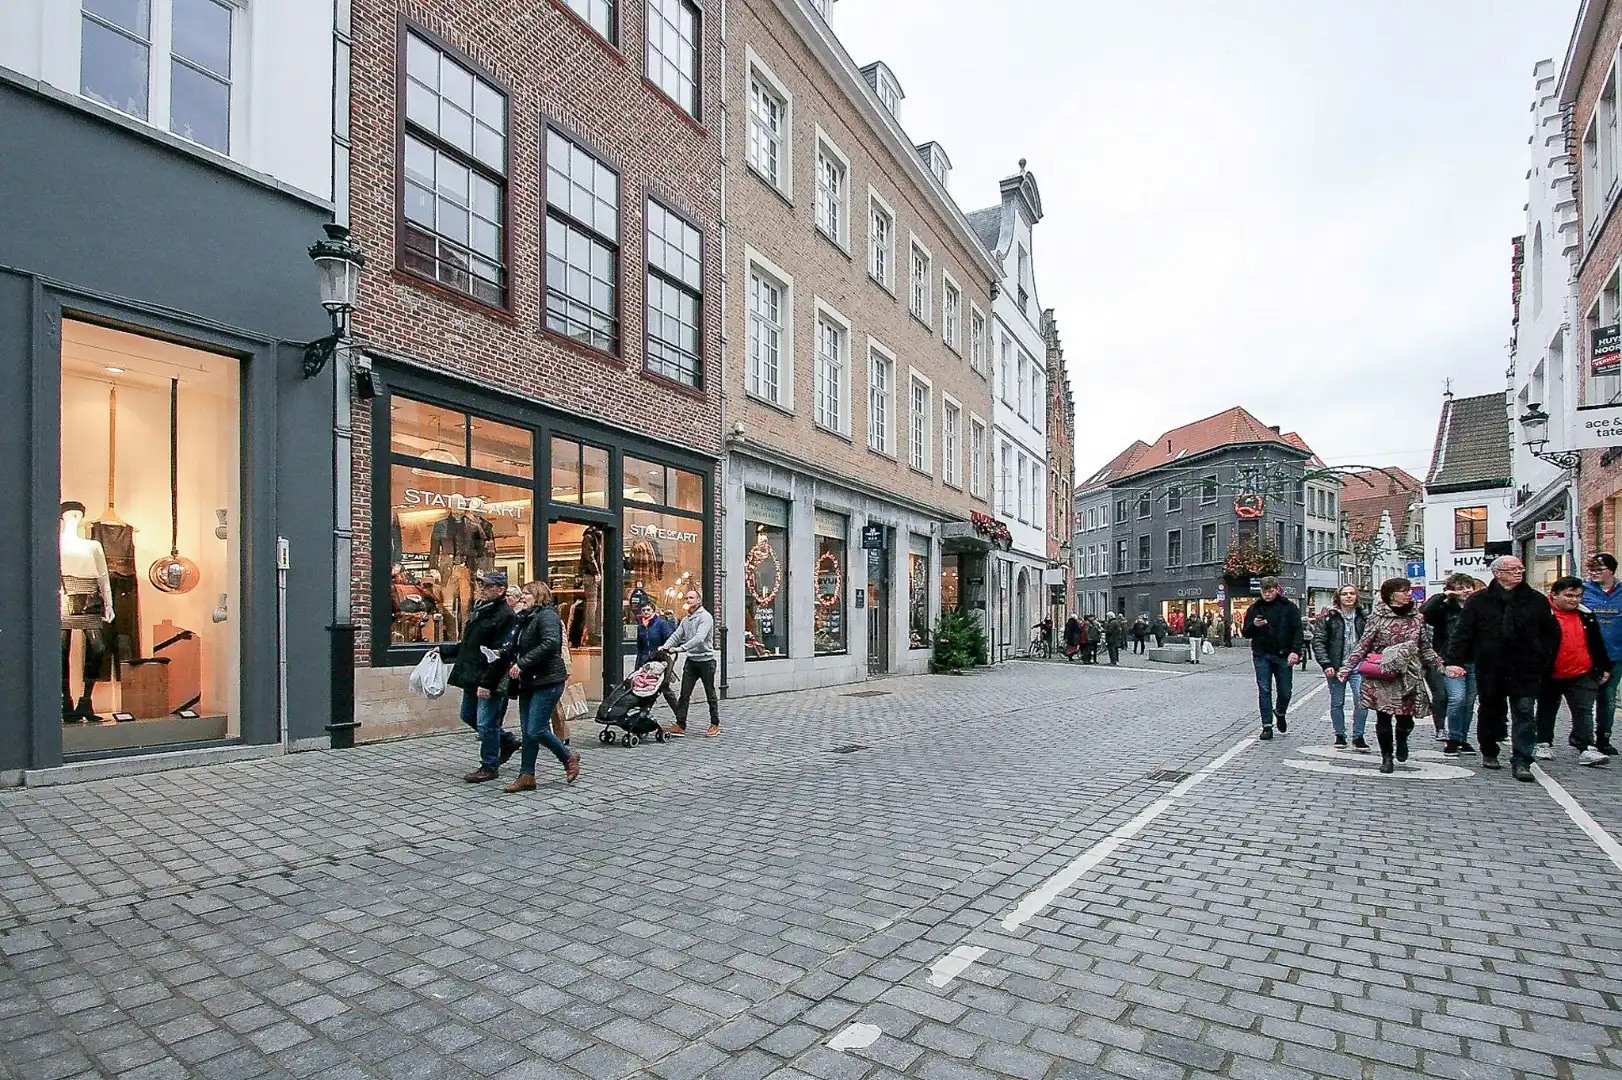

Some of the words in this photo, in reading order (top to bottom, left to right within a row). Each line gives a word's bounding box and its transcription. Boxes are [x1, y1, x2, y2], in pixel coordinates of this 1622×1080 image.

[1585, 419, 1610, 429] ace
[1613, 417, 1622, 426] &
[1596, 427, 1622, 438] tate
[404, 488, 468, 510] STATE
[486, 502, 524, 519] ART
[629, 523, 667, 539] STATE
[677, 531, 698, 543] ART
